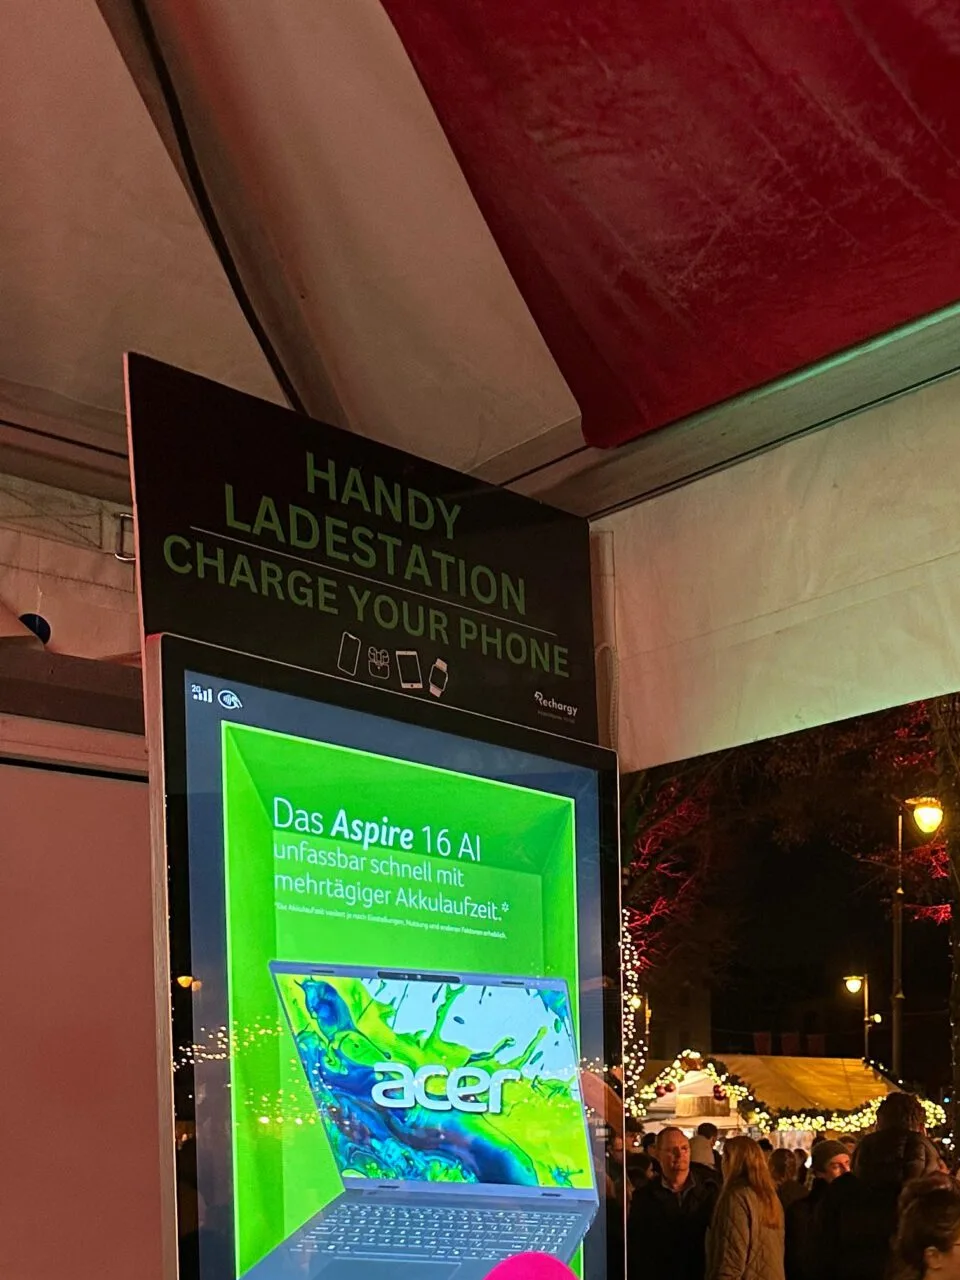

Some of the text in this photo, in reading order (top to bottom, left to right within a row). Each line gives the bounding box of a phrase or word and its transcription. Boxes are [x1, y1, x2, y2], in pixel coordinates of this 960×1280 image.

[306, 451, 461, 540] HANDY
[224, 483, 526, 615] LADESTATION
[162, 534, 570, 678] CHARGE YOUR PHONE
[534, 690, 578, 717] Rechargy
[273, 796, 481, 862] Das Aspire 16 AI
[273, 840, 464, 888] unfassbar schnell mit
[274, 872, 391, 908] mehrtägiger
[371, 1061, 521, 1114] acer
